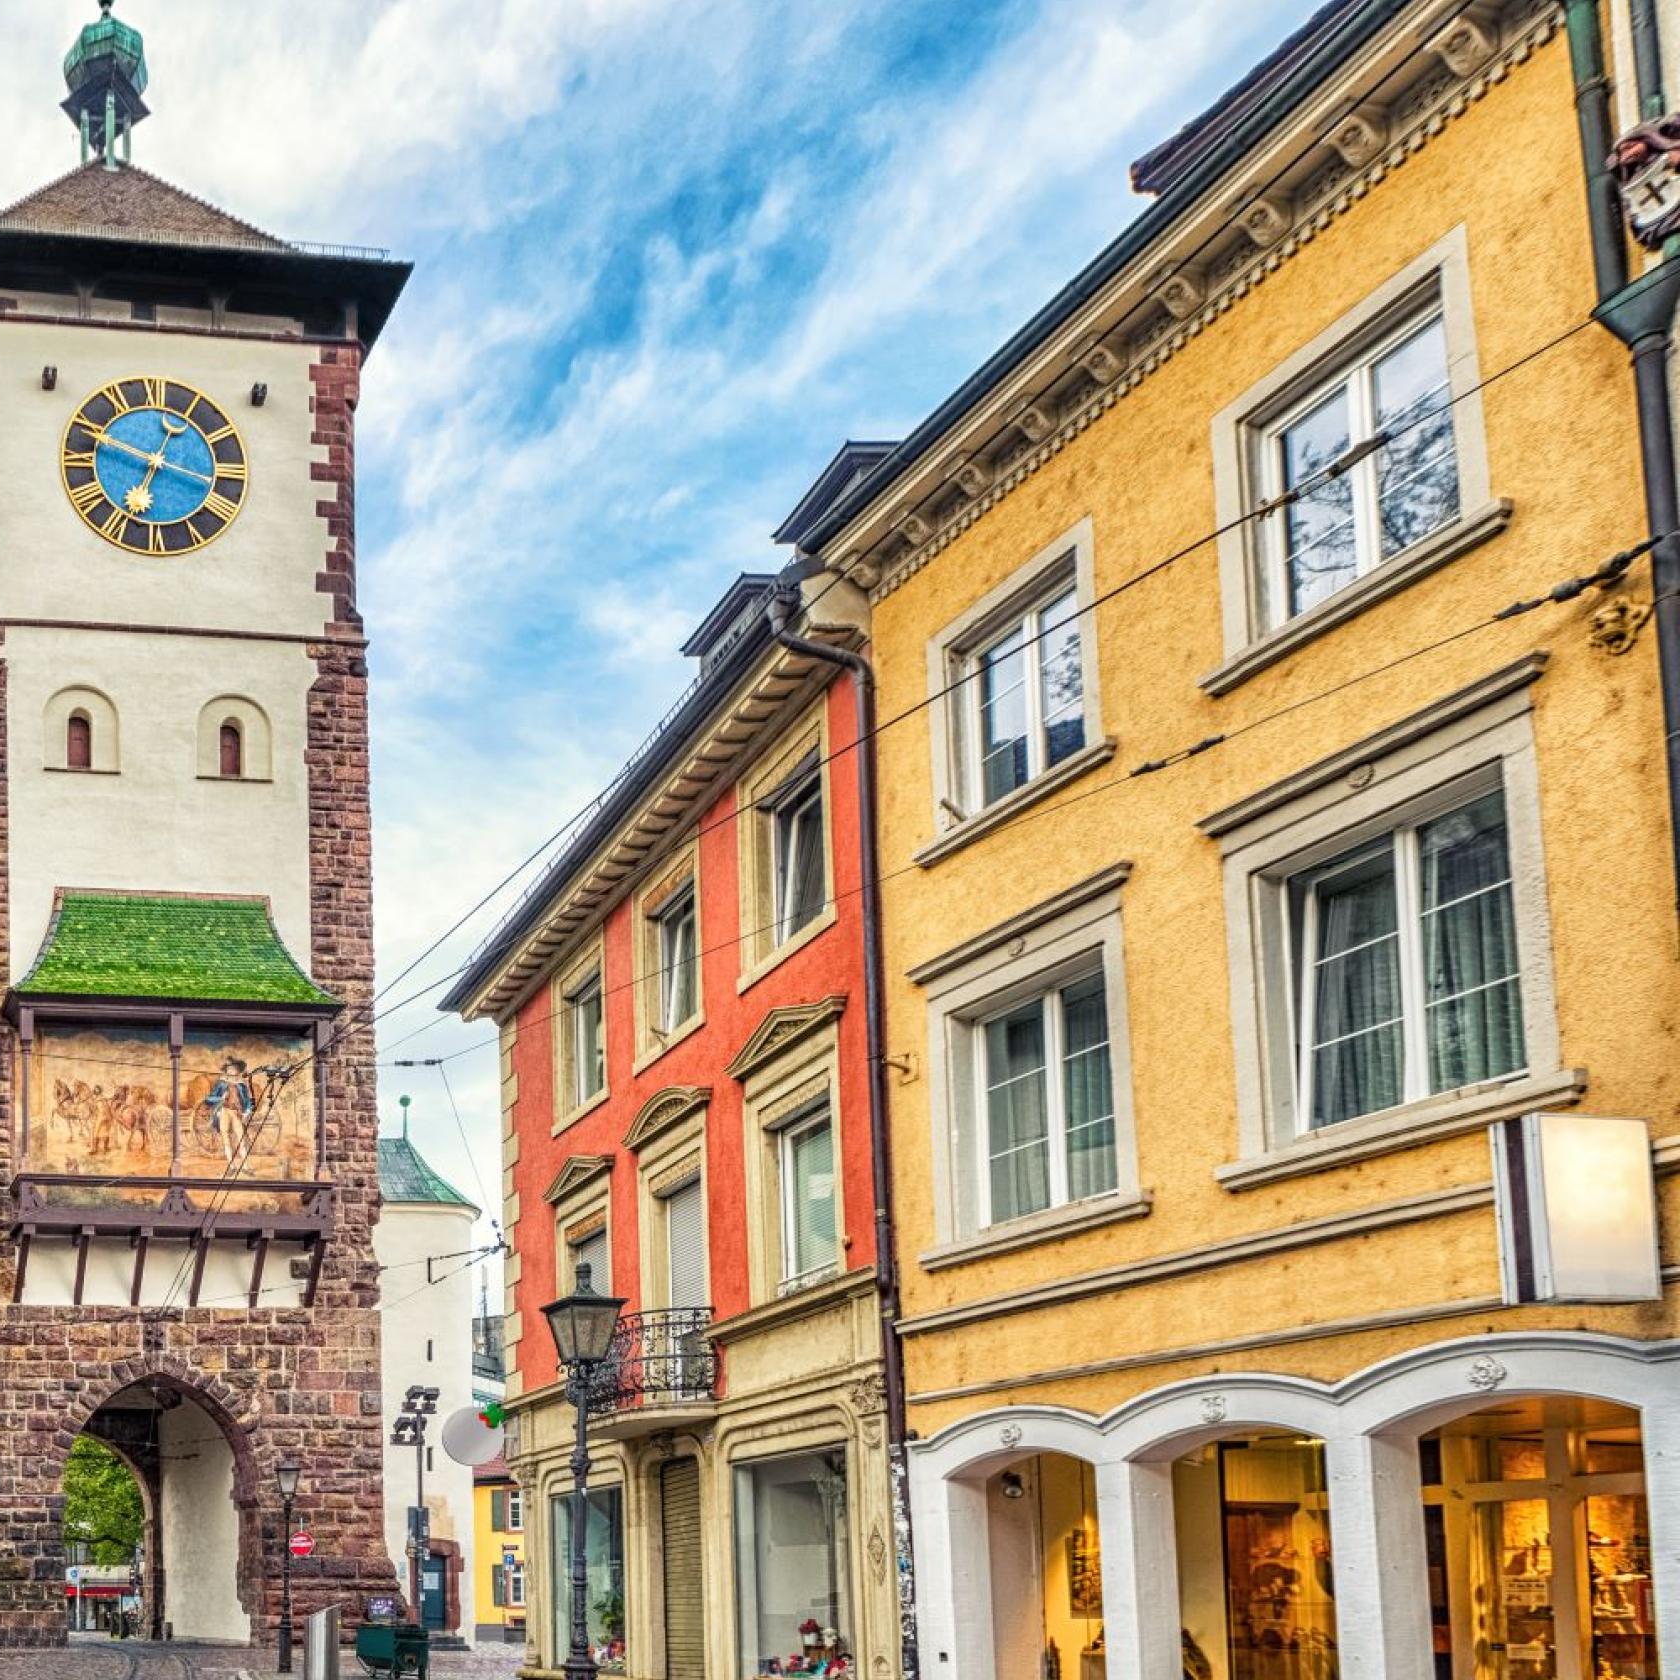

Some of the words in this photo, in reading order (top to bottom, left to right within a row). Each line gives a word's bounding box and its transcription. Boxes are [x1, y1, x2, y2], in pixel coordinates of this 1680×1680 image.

[104, 385, 130, 413] XI
[143, 378, 166, 408] XII
[186, 393, 201, 418] I
[207, 425, 235, 444] II
[215, 463, 245, 480] III
[70, 482, 105, 515] VIII
[204, 493, 238, 521] IIII
[101, 510, 128, 543] VII
[149, 523, 166, 553] VI
[186, 520, 205, 546] V
